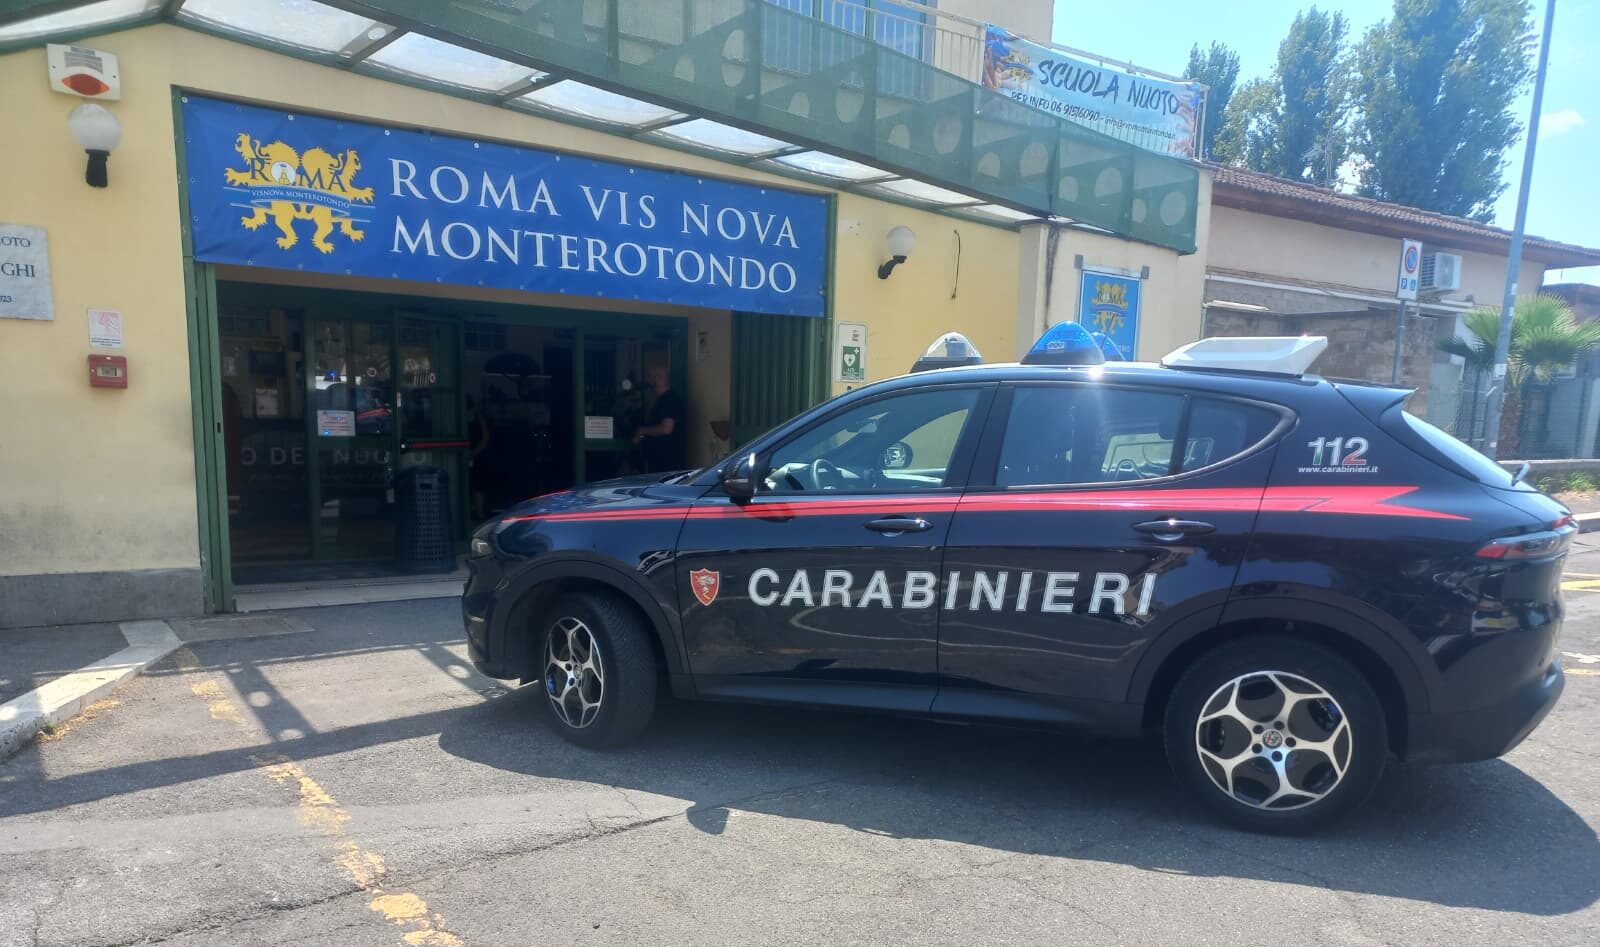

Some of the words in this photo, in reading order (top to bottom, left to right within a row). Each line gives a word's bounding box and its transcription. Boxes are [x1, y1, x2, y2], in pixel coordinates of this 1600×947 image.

[1038, 59, 1120, 104] SCUOLA
[1128, 79, 1180, 116] NUOTO
[1030, 95, 1050, 110] INFO
[1051, 100, 1062, 113] 06
[286, 190, 350, 208] MONTEROTONDO
[387, 157, 561, 217] ROMA
[579, 184, 656, 229] VIS
[680, 200, 801, 249] NOVA
[0, 235, 31, 248] OTO
[391, 215, 798, 294] MONTEROTONDO
[270, 448, 304, 466] DE
[1307, 436, 1369, 466] 112
[1297, 465, 1379, 473] www.carabinieri.it
[747, 566, 1158, 617] CARABINIERI
